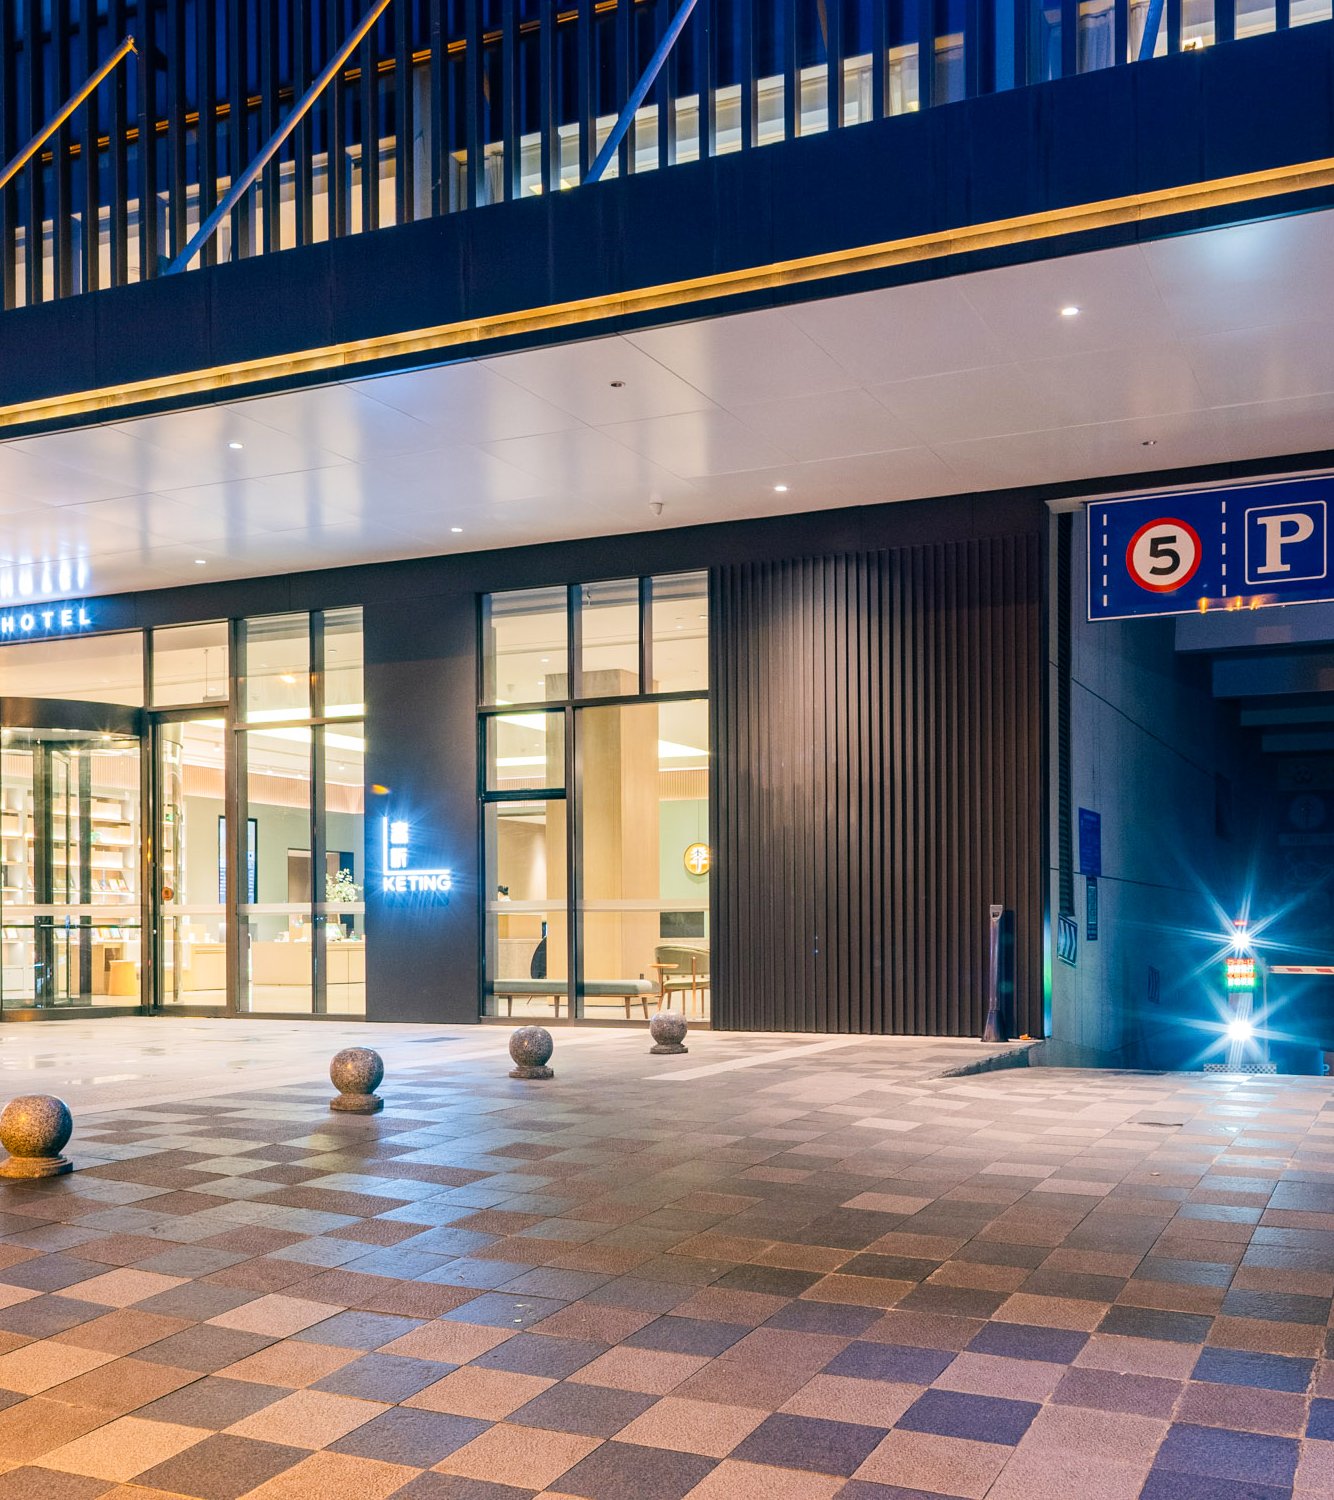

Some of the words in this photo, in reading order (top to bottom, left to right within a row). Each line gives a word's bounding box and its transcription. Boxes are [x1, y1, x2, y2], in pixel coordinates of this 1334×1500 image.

[1148, 536, 1180, 576] 5
[1256, 512, 1315, 575] P
[1, 608, 91, 634] HOTEL
[382, 874, 452, 892] KETING
